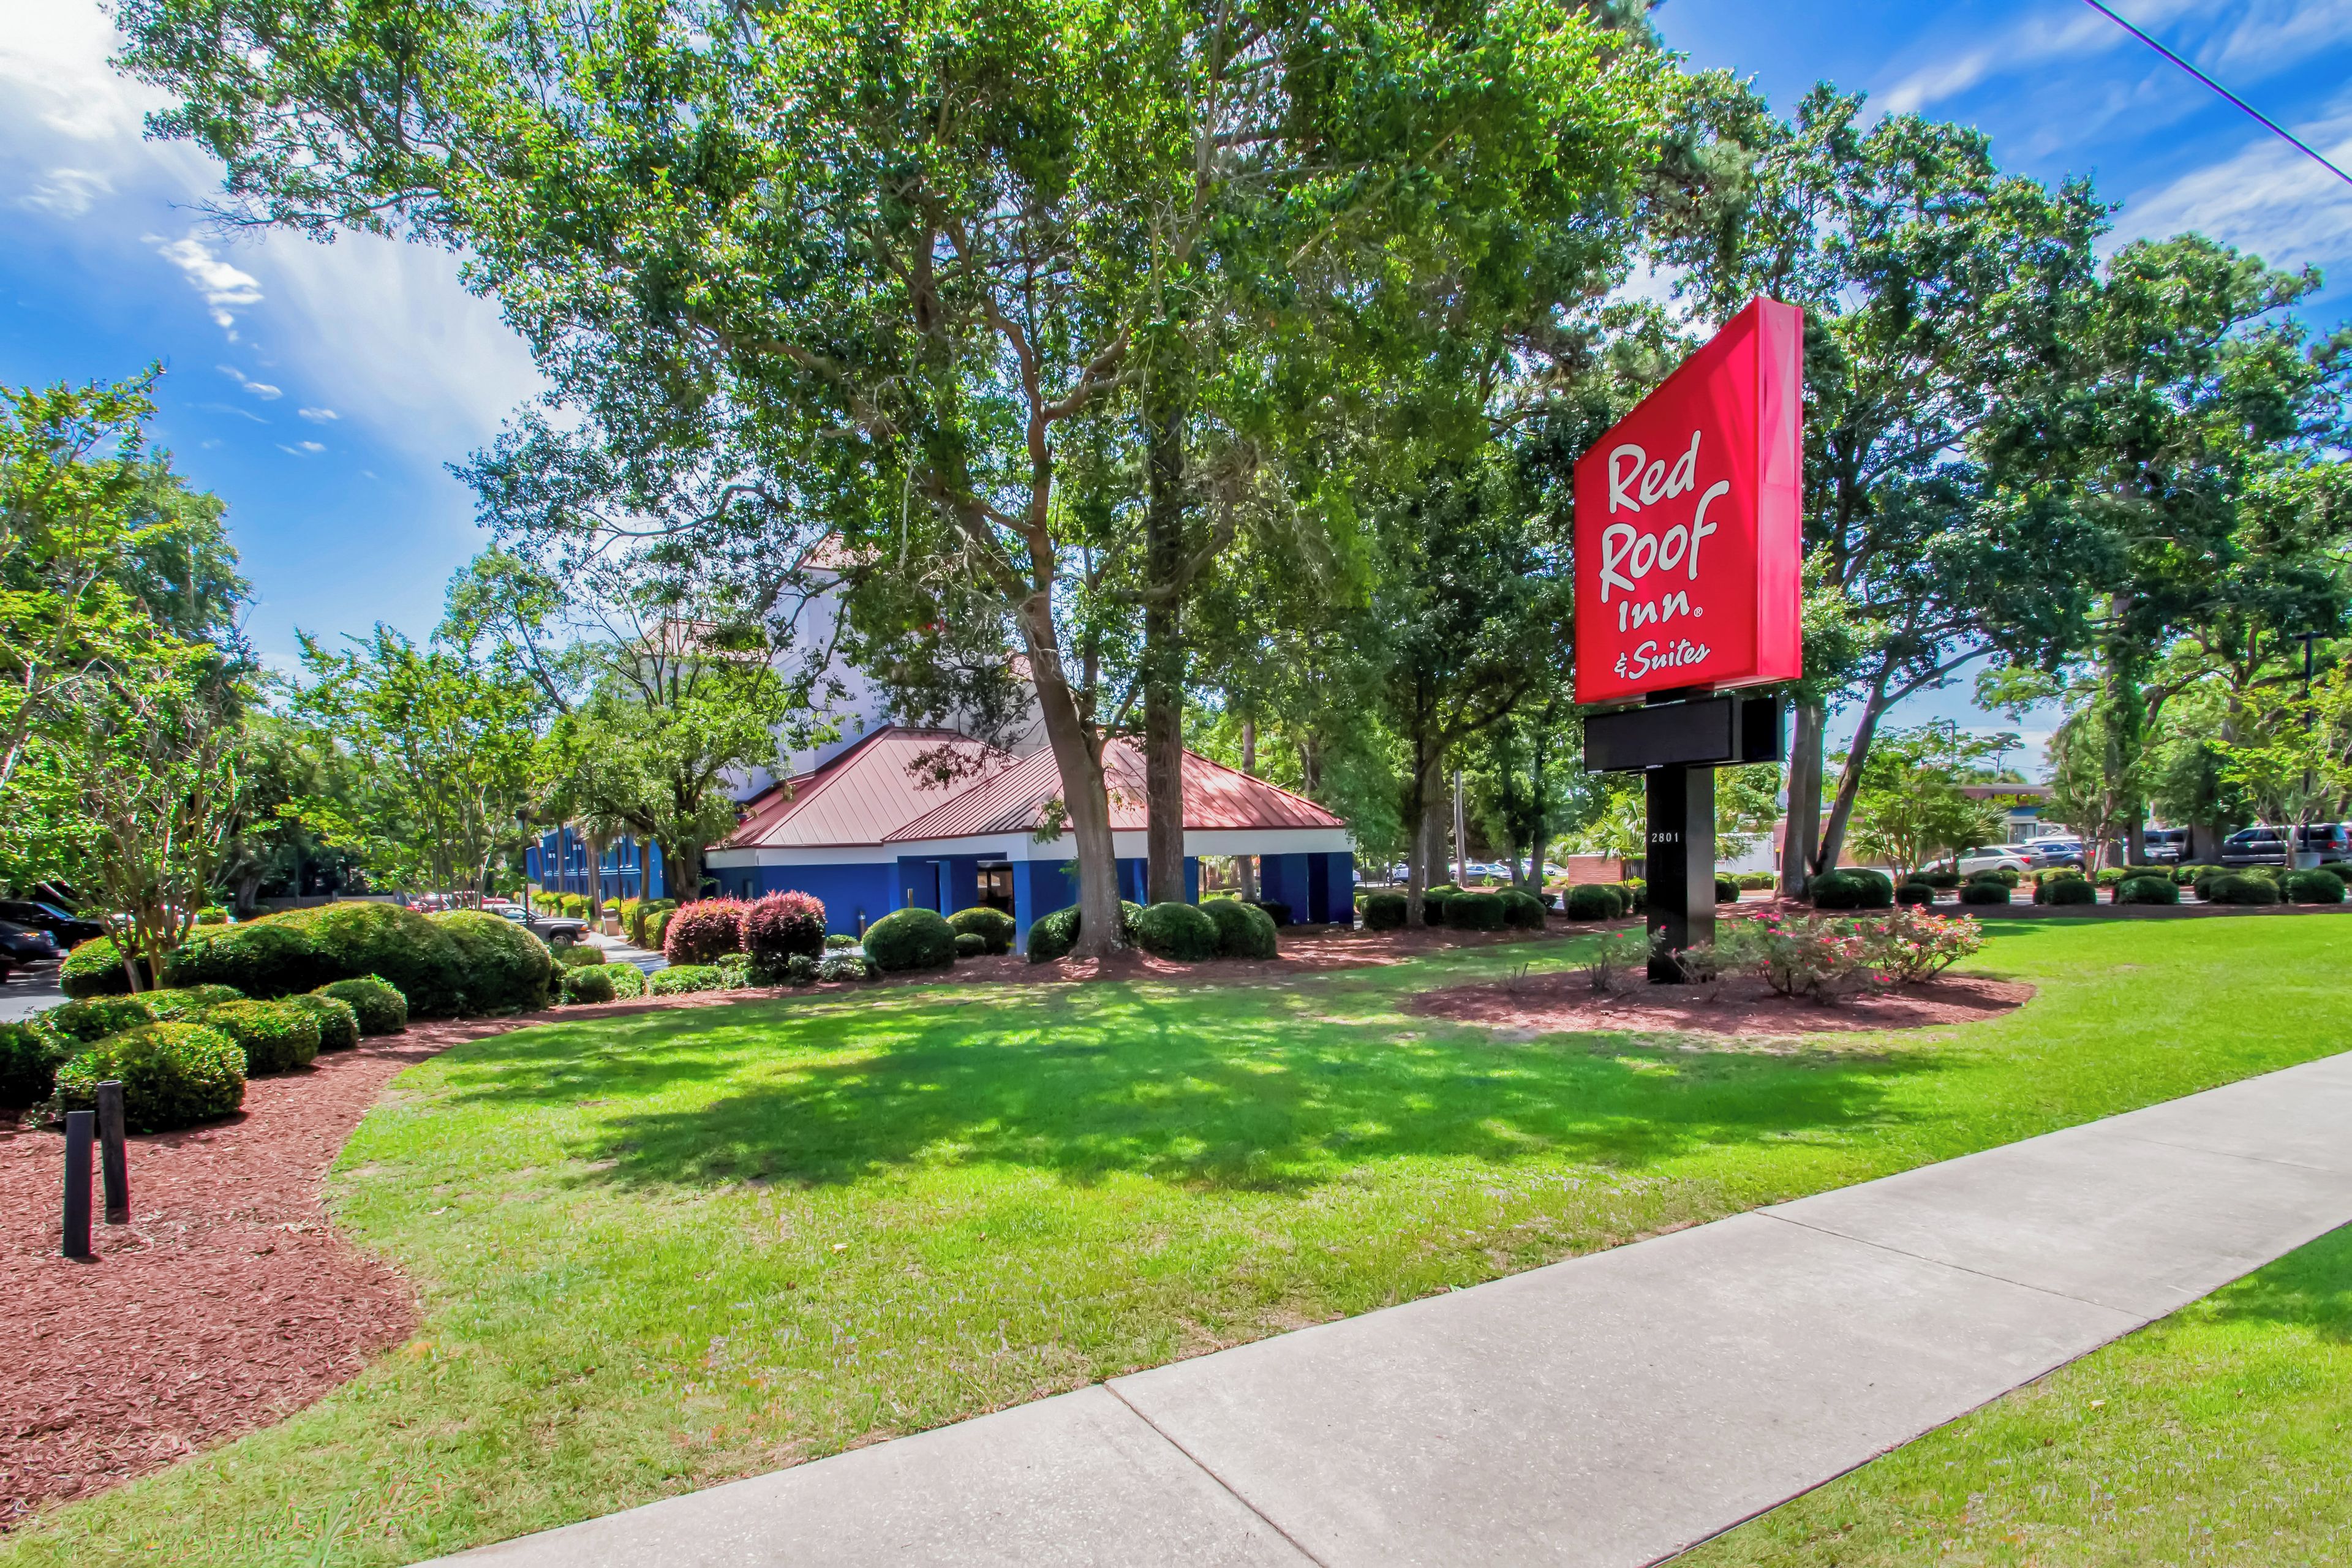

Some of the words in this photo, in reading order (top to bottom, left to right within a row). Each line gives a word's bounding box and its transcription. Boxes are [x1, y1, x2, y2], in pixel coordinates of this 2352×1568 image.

[1608, 430, 1701, 514] Red
[1599, 480, 1730, 603] Roof
[1628, 638, 1711, 680] Suites
[1651, 832, 1678, 843] 2801
